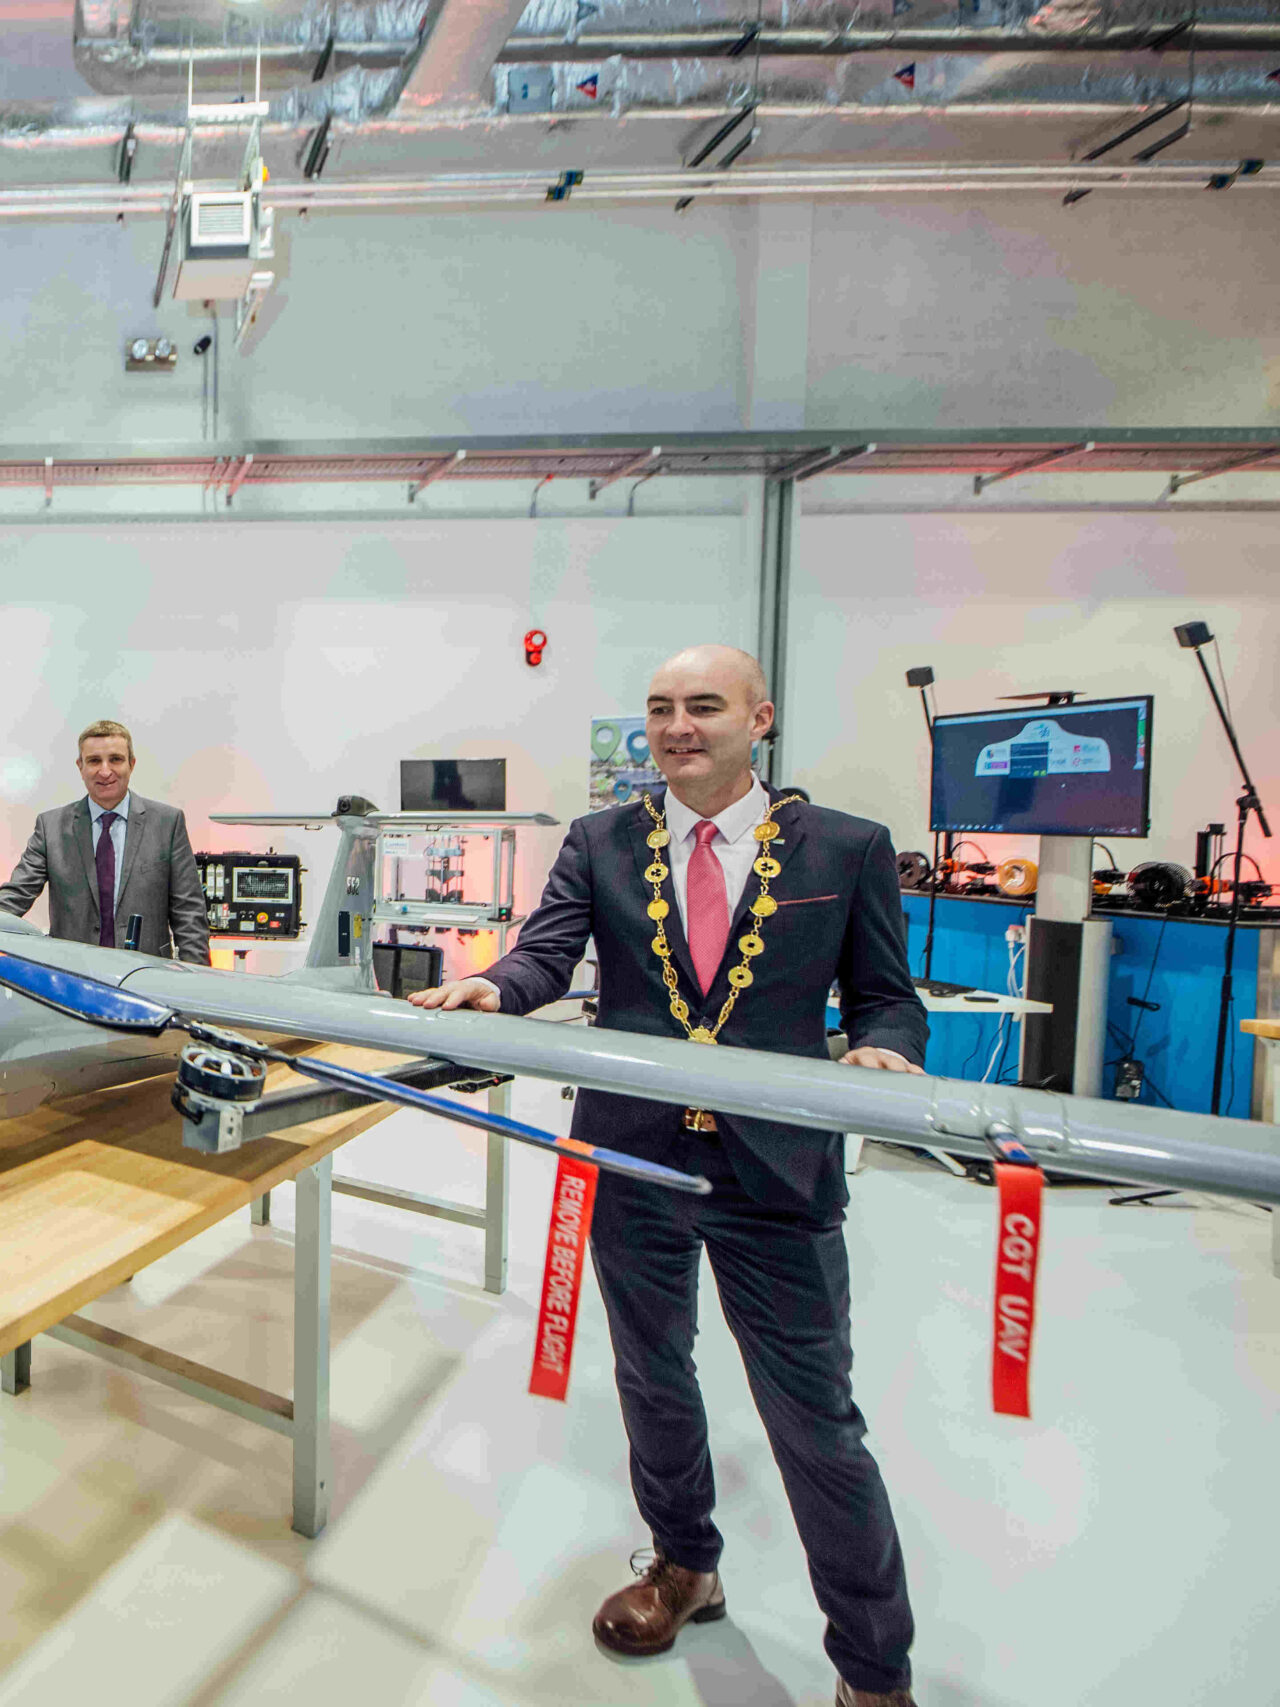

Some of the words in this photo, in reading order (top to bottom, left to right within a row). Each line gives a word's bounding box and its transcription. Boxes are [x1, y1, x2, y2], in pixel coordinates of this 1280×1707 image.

[556, 1174, 585, 1247] REMOVE
[548, 1247, 576, 1314] BEFORE
[1002, 1213, 1035, 1282] CGT
[541, 1313, 568, 1374] FLIGHT
[998, 1295, 1029, 1361] UAV
